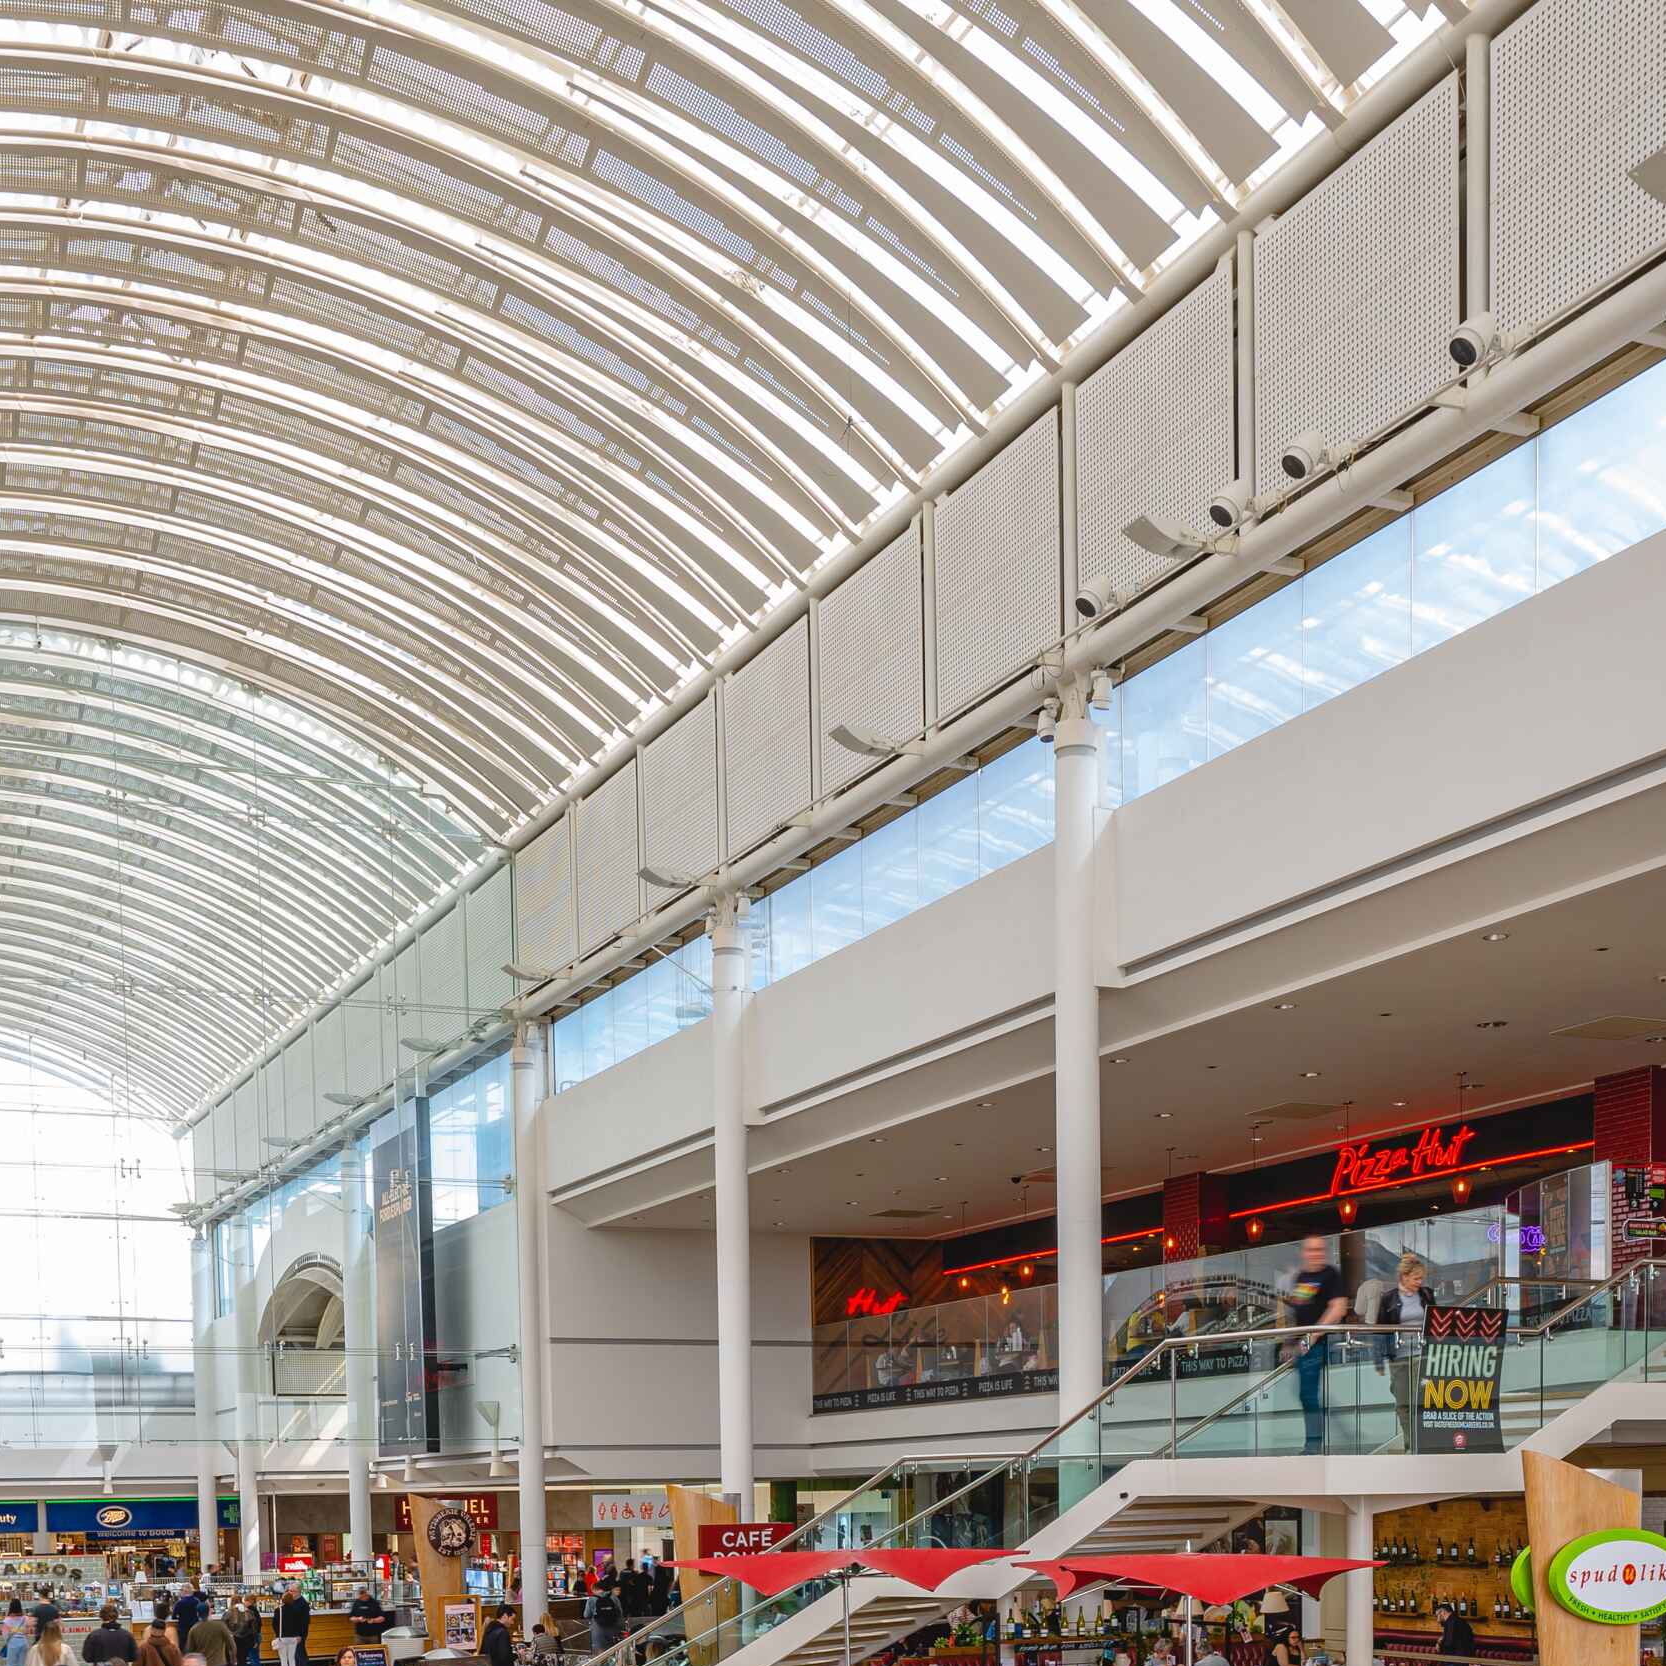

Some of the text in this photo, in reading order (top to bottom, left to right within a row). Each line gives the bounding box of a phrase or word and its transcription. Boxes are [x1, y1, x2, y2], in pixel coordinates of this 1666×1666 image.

[1330, 1126, 1476, 1197] Pizza Hut
[845, 1287, 908, 1315] Hut
[1425, 1344, 1497, 1378] HIRING
[1424, 1379, 1494, 1409] NOW
[721, 1527, 774, 1547] CAFÉ
[1568, 1595, 1590, 1615] FRESH
[1598, 1612, 1630, 1621] HEALTHY
